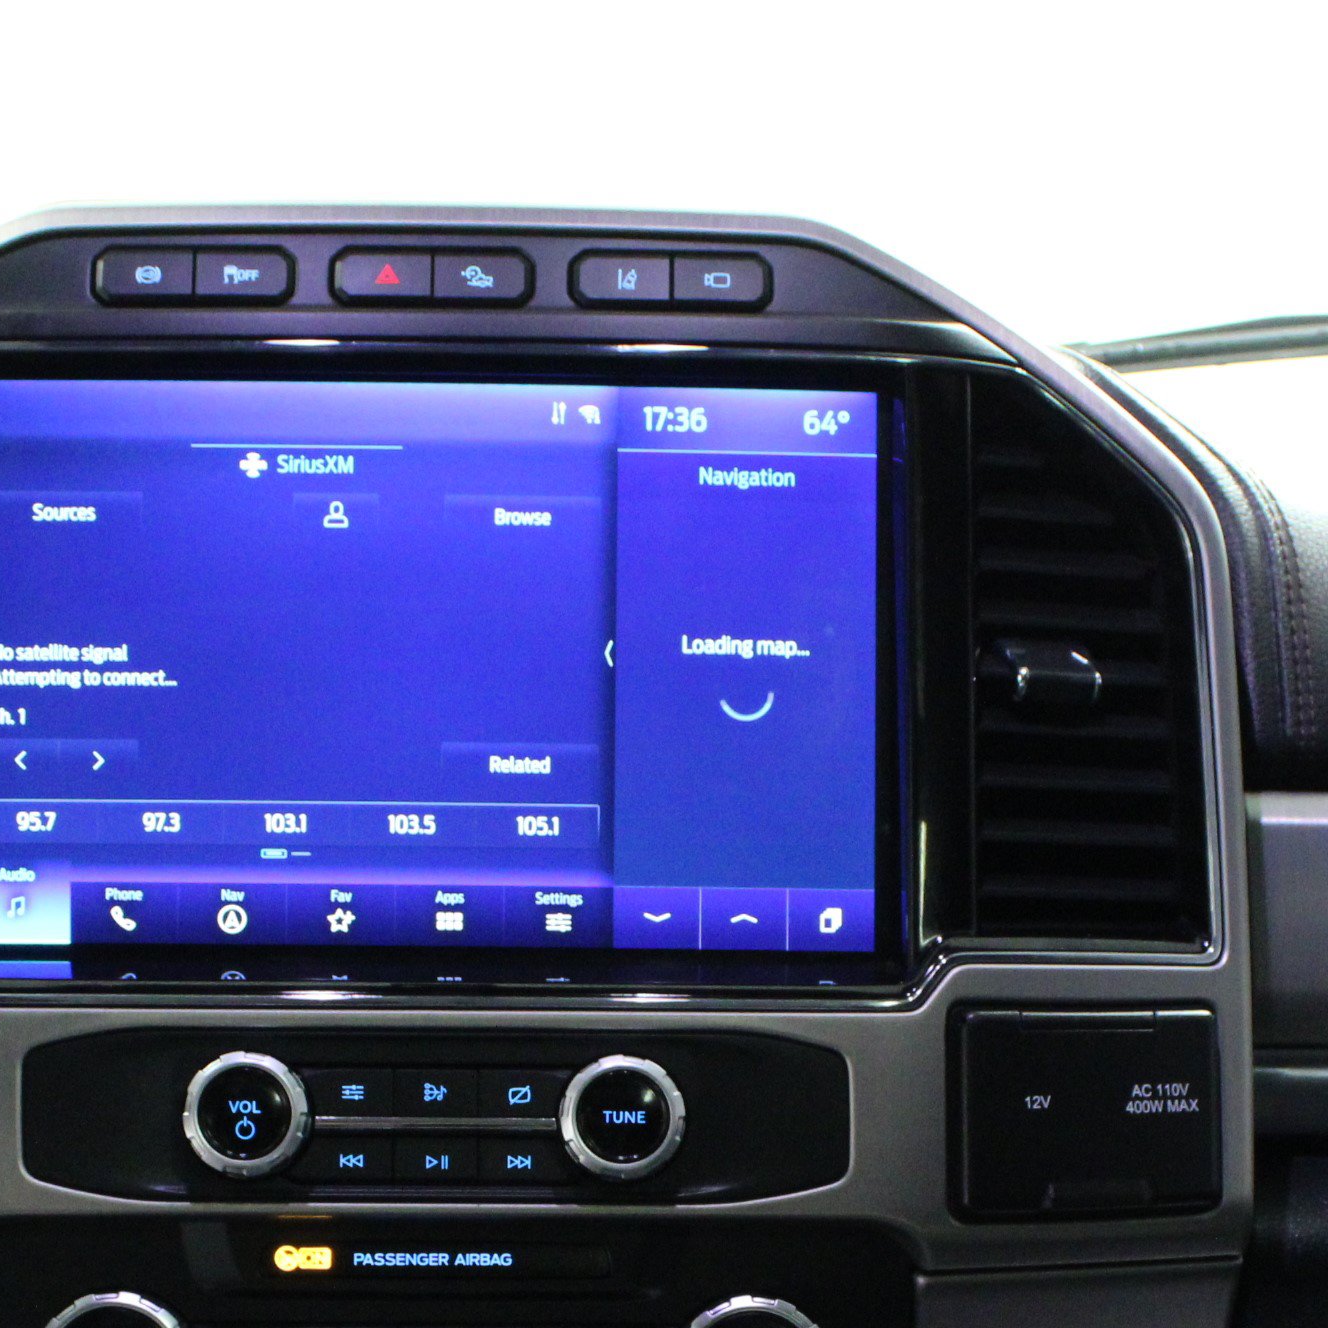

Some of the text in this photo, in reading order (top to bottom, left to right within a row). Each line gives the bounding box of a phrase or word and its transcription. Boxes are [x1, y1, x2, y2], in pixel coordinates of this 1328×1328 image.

[643, 405, 708, 433] 17:36
[802, 409, 851, 436] 64°
[276, 454, 355, 476] SiriusXM
[698, 466, 796, 490] Navigation
[32, 503, 96, 523] Sources
[493, 506, 552, 527] Browse
[15, 643, 80, 662] satellite
[80, 643, 129, 665] signal
[681, 634, 754, 658] Loading
[83, 668, 101, 687] to
[17, 706, 27, 726] 1
[488, 754, 552, 775] Related
[16, 811, 57, 832] 95.7
[142, 812, 182, 833] 97.3
[263, 812, 308, 834] 103.1
[387, 813, 437, 835] 103.5
[516, 815, 561, 837] 105.1
[104, 886, 144, 903] Phone
[219, 888, 245, 904] Nav
[329, 889, 353, 904] Fav
[434, 890, 466, 907] Apps
[534, 890, 584, 908] Settings
[1130, 1082, 1190, 1098] AC 110V
[228, 1099, 262, 1115] VOL
[1024, 1095, 1052, 1110] 12V
[1125, 1098, 1200, 1115] 400W MAX
[602, 1109, 647, 1125] TUNE
[353, 1251, 513, 1268] PASSENGER AIRBAG
